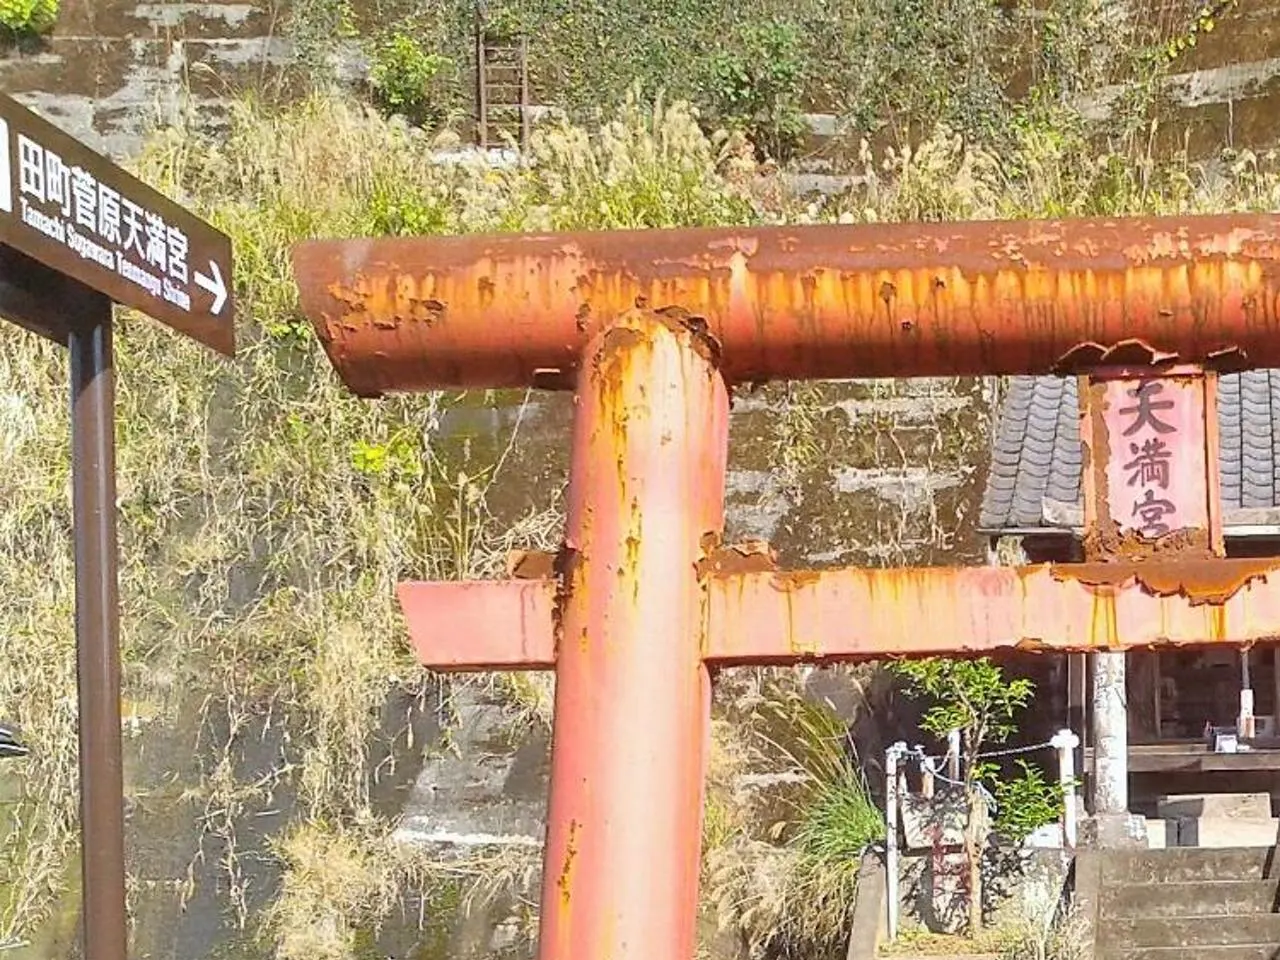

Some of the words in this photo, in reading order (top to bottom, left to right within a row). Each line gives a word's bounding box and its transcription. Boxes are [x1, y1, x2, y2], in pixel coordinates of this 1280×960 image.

[18, 133, 189, 285] 田町菅原天満宮
[1118, 378, 1178, 537] 天満宮
